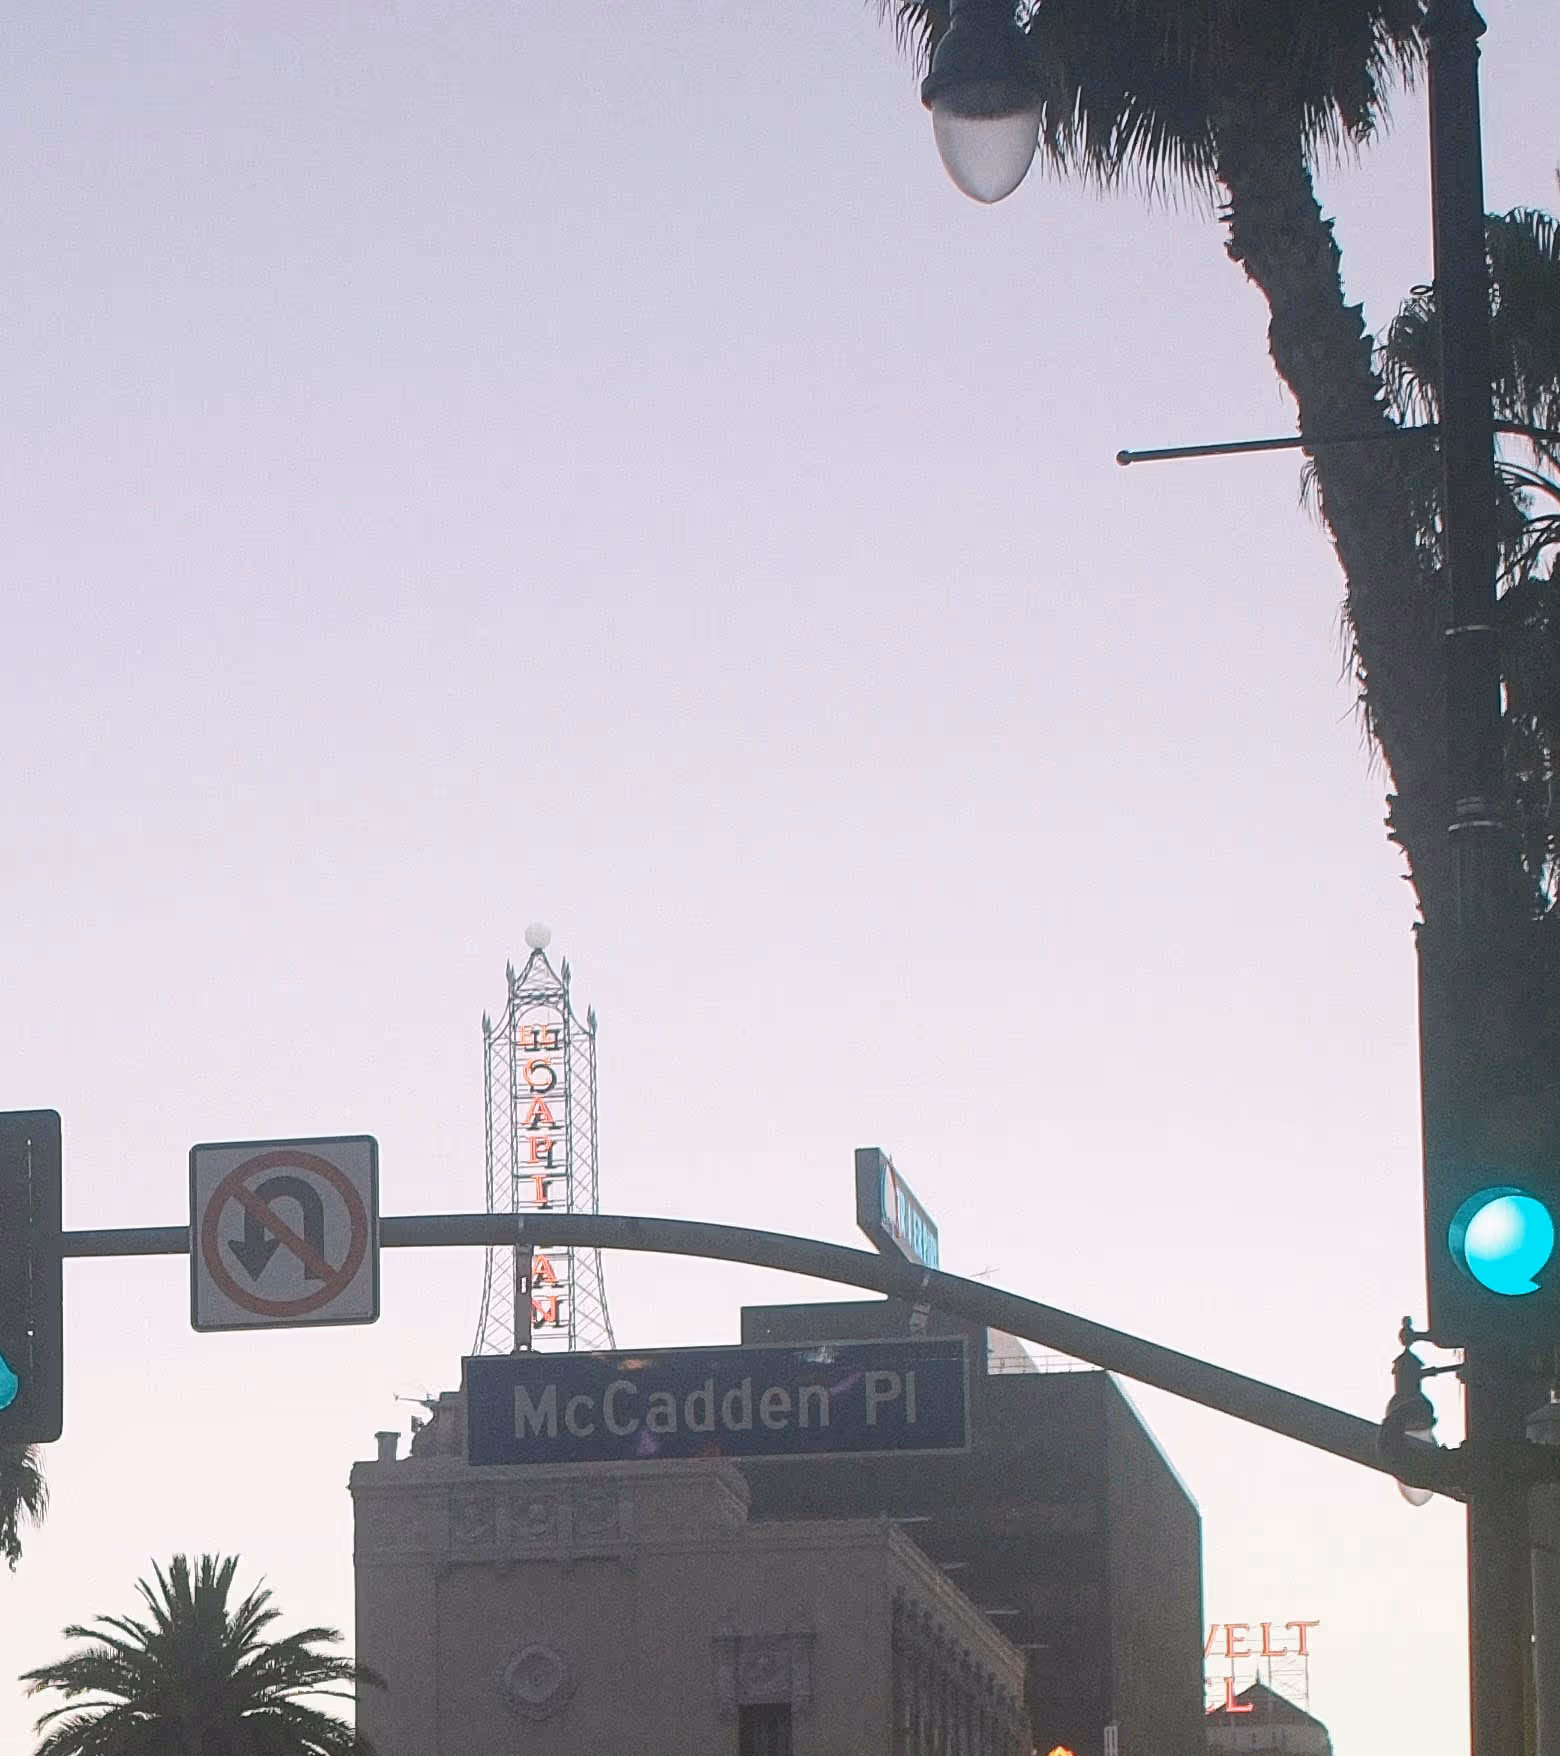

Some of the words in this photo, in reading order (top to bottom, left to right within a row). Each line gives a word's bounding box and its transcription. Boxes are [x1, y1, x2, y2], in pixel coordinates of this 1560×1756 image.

[522, 1057, 559, 1330] CAPIAN
[513, 1378, 832, 1440] McCadden
[864, 1370, 919, 1426] Pl
